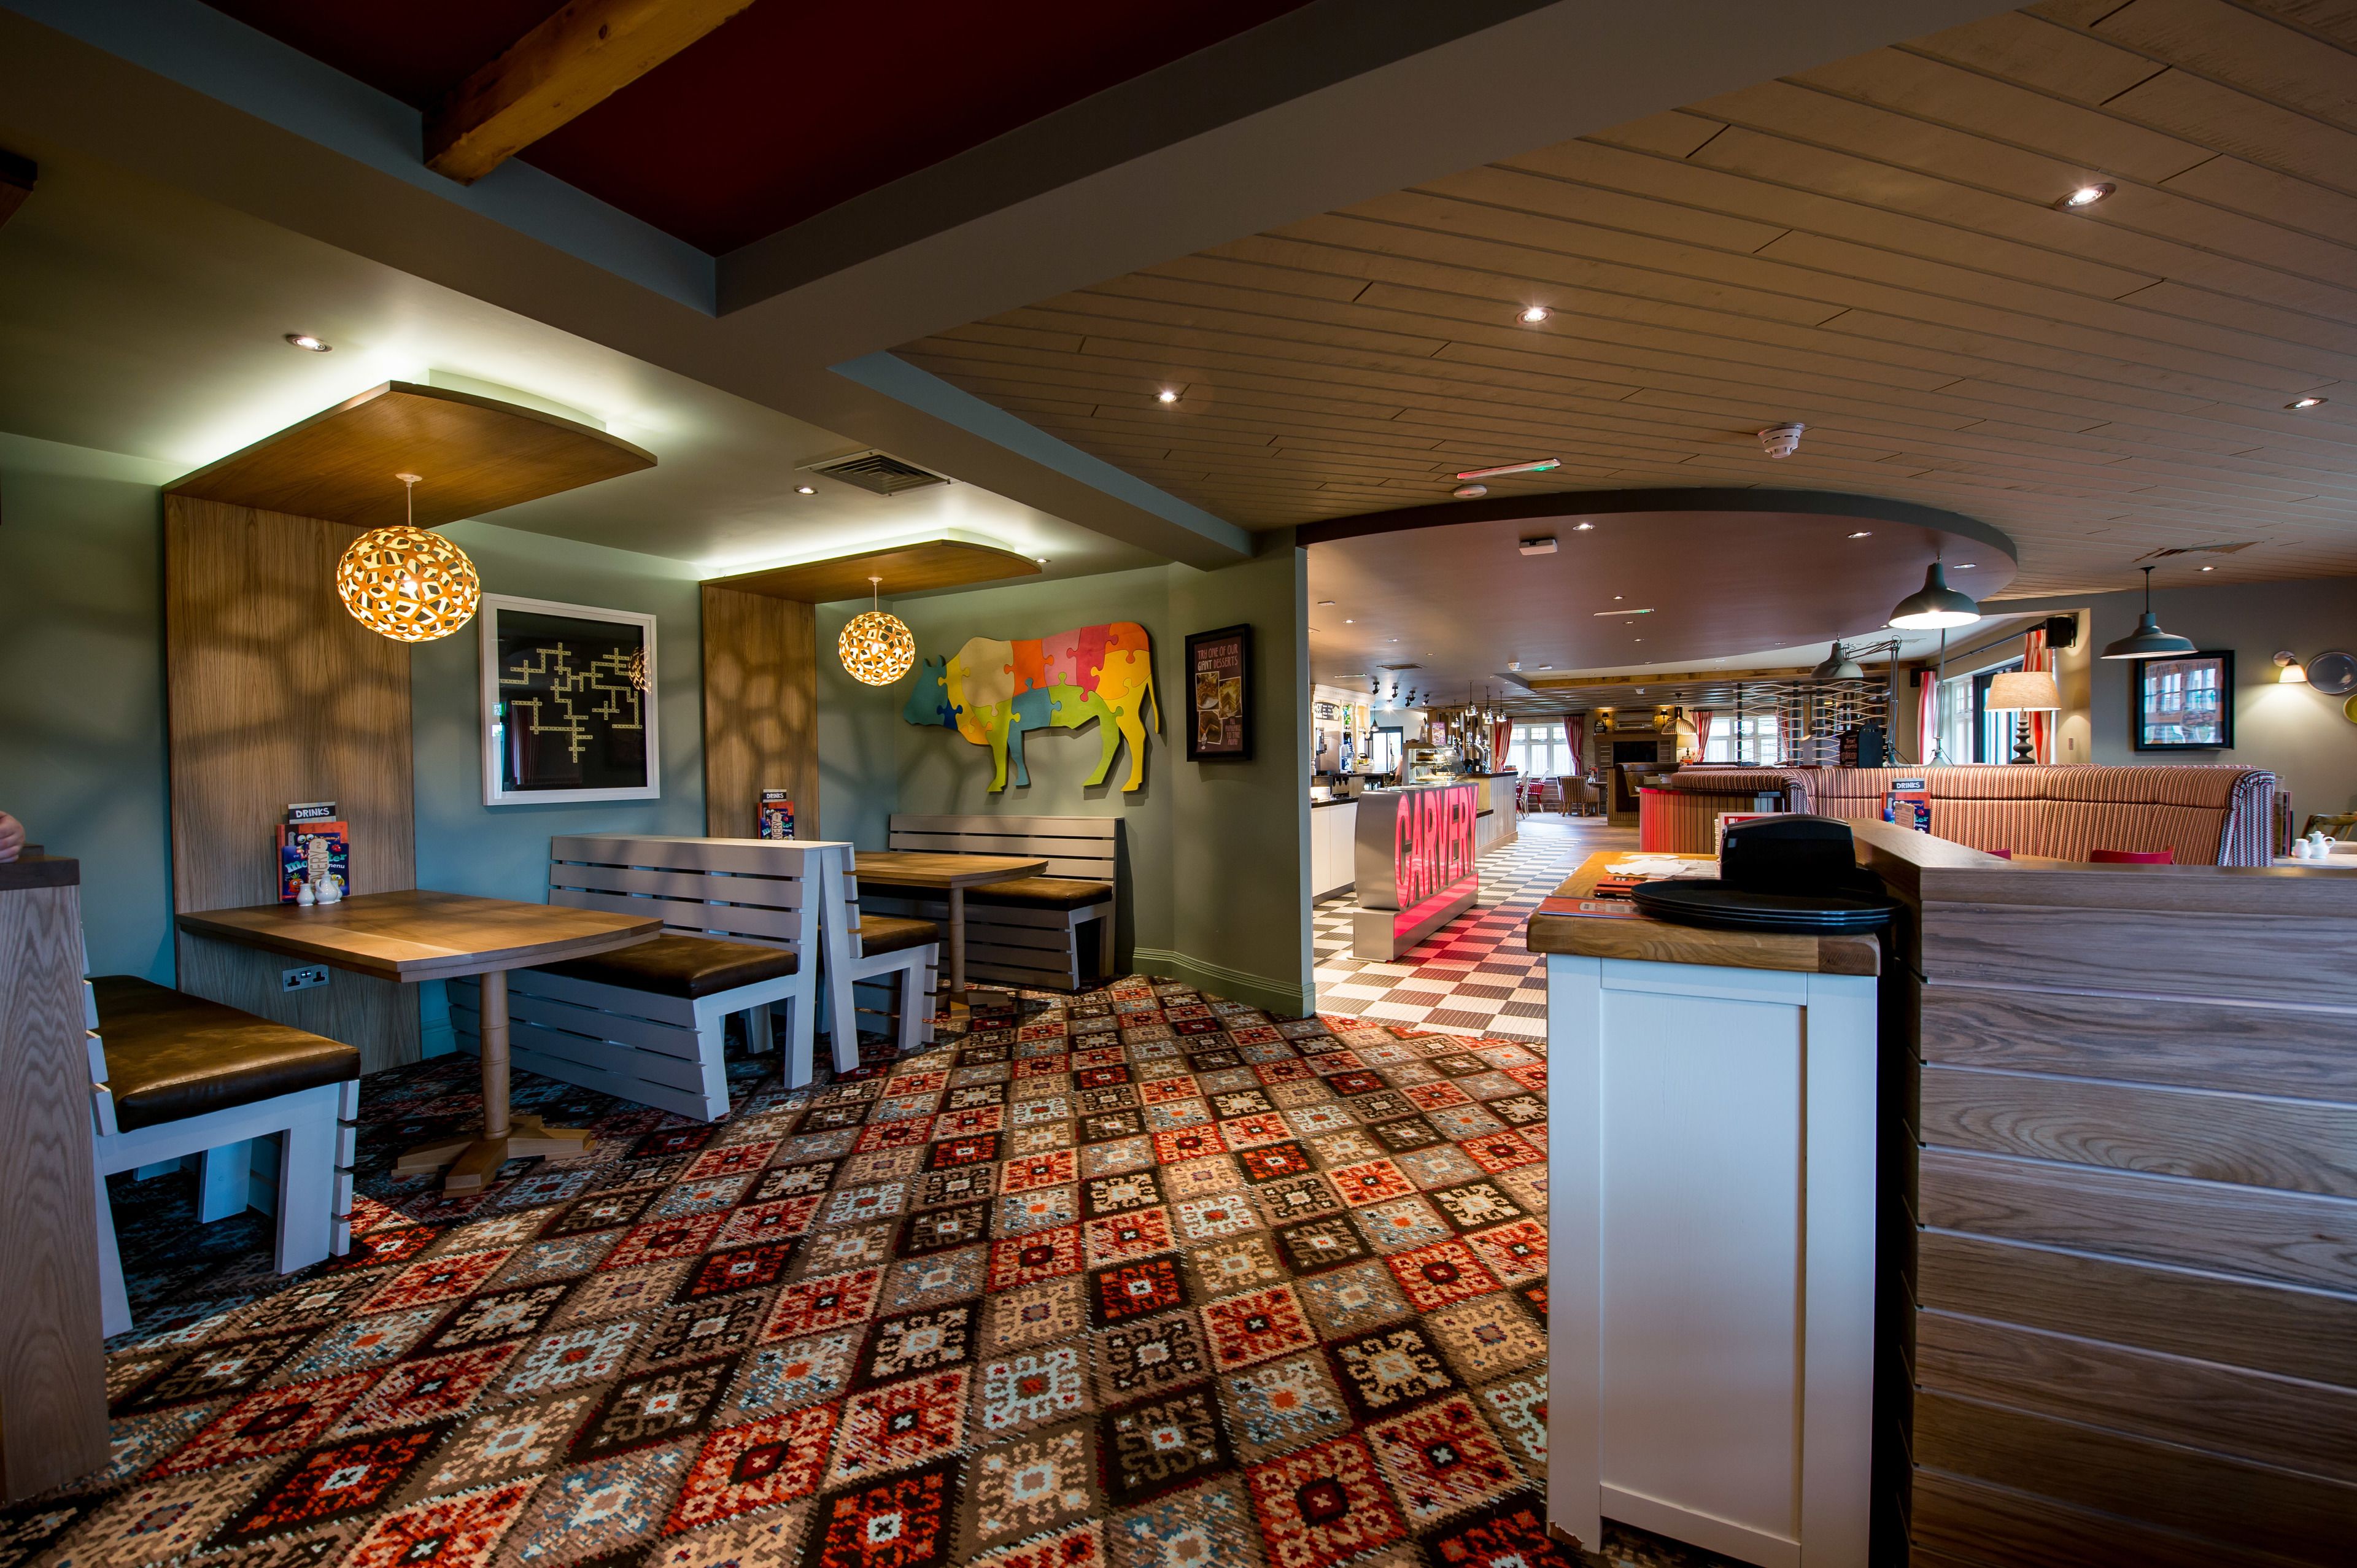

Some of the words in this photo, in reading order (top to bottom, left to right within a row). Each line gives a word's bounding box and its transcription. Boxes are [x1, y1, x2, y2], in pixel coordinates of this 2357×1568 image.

[1198, 649, 1207, 659] TRY
[1209, 647, 1218, 658] ONE
[1220, 646, 1226, 656] OF
[1227, 644, 1238, 654] OUR
[1198, 660, 1213, 671] GIANT
[1213, 655, 1237, 669] DESSERTS
[295, 808, 330, 817] DRINKS
[1395, 786, 1479, 908] CARVERY
